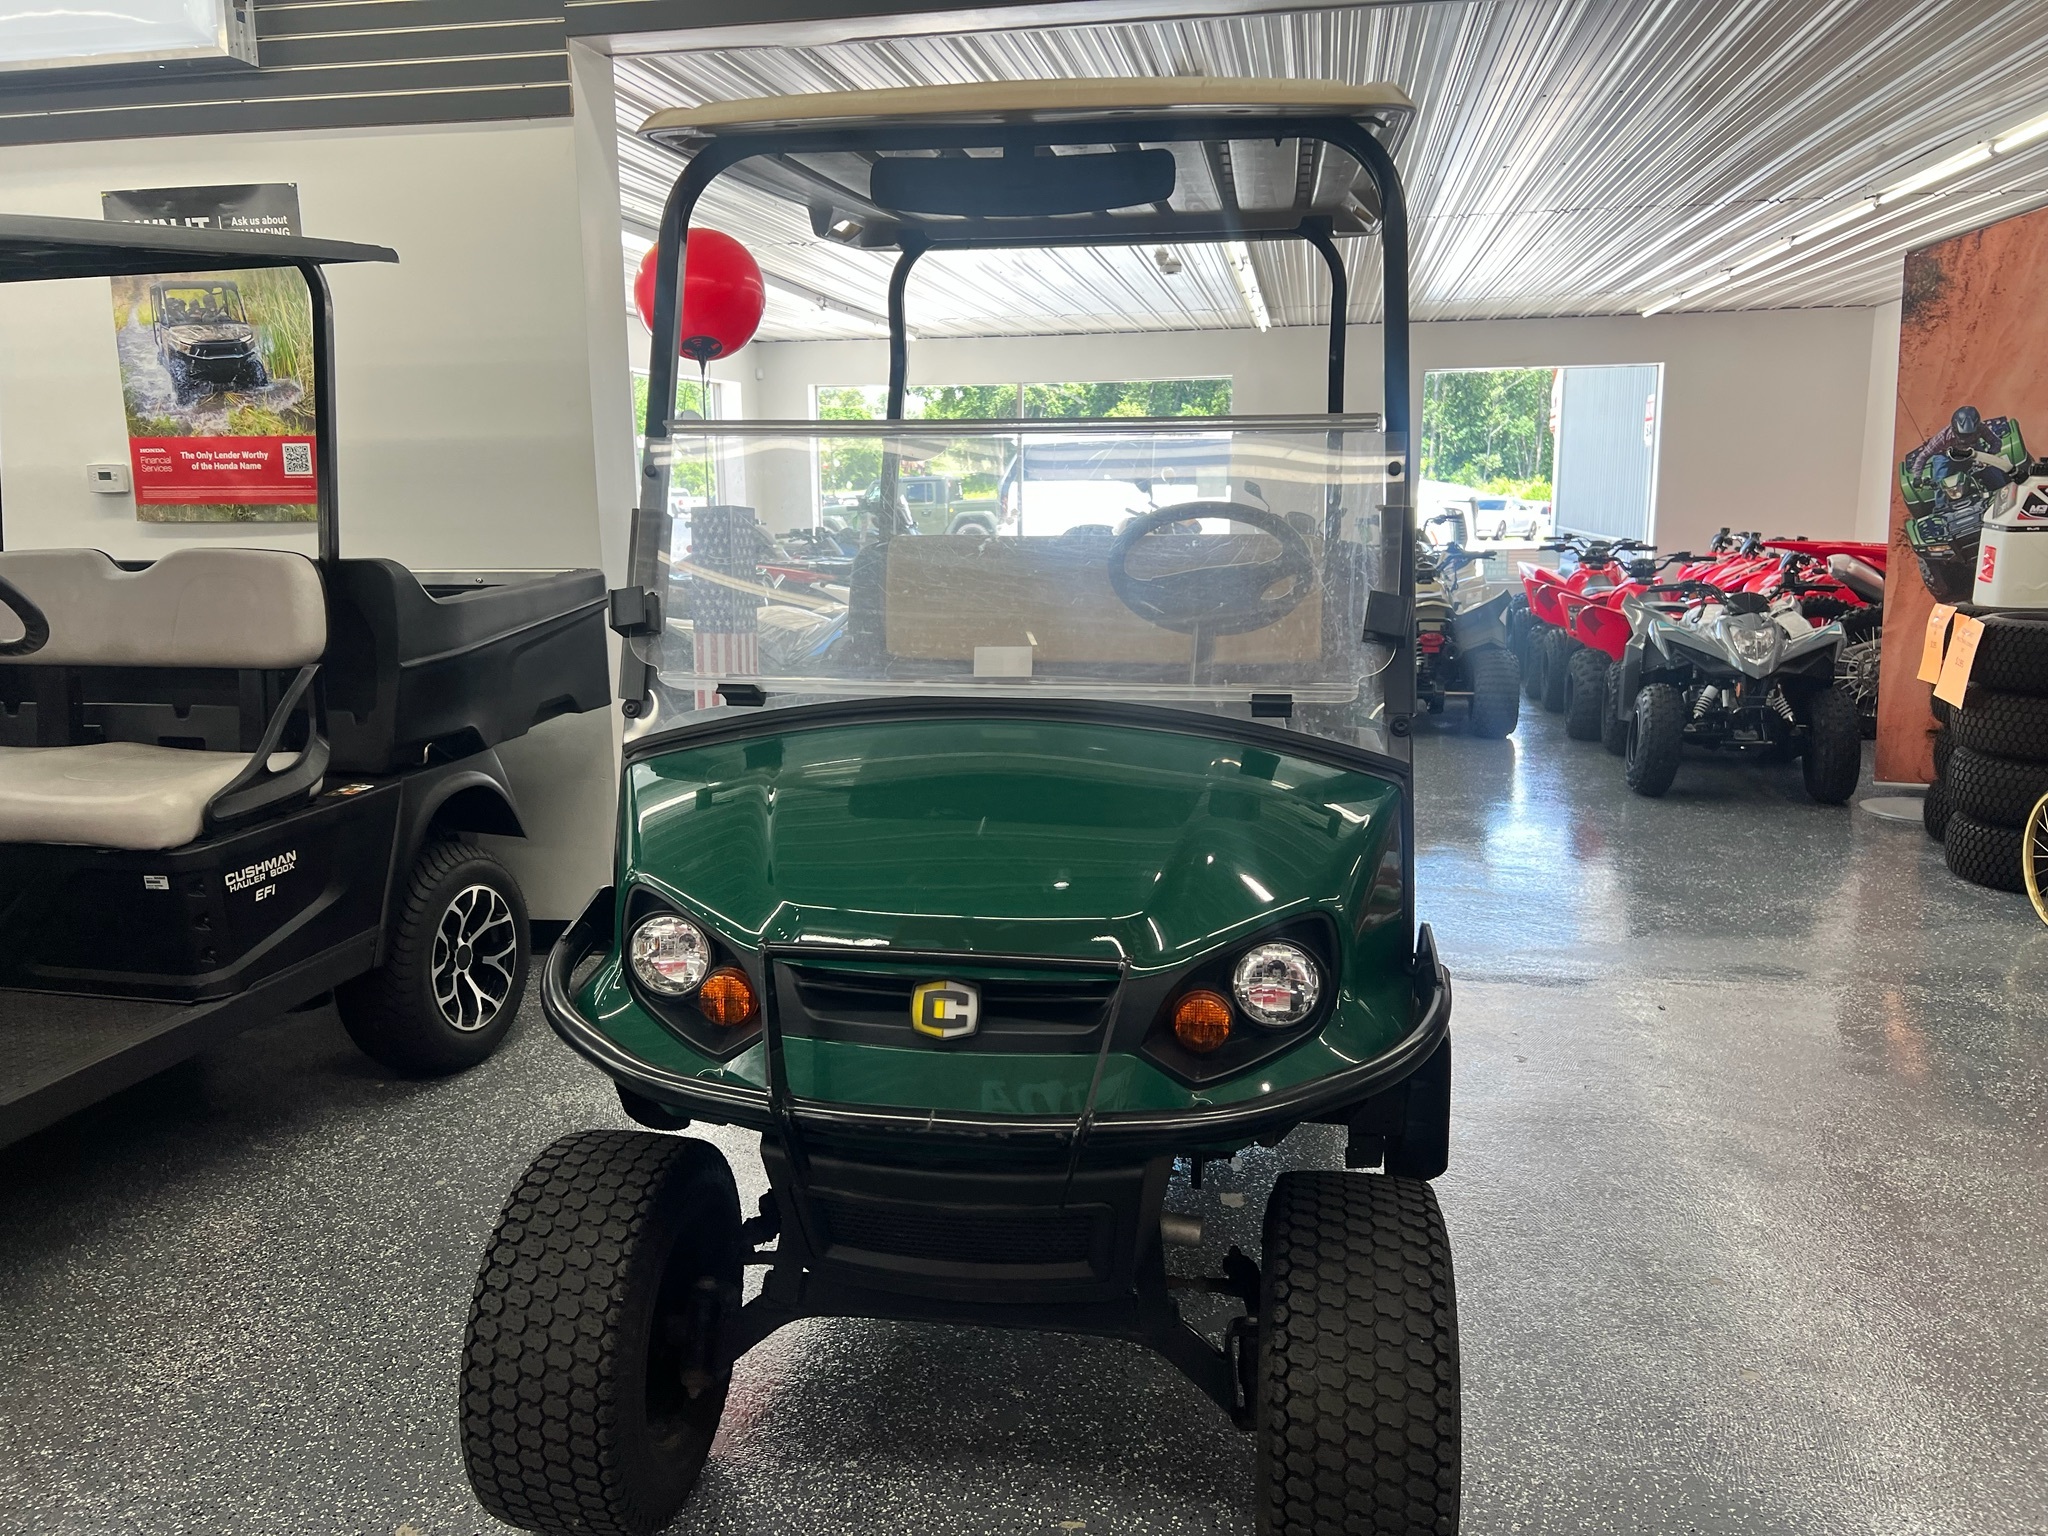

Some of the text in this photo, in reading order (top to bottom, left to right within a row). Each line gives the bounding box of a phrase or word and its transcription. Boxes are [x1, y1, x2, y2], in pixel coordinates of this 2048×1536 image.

[231, 215, 288, 226] Ask us about
[140, 456, 172, 465] Financial
[180, 450, 269, 461] The Only Lender Worthy
[141, 464, 173, 473] Services
[191, 461, 262, 470] of the Honda Name
[224, 850, 297, 886] CUSHMAN
[229, 874, 266, 893] HAULER
[255, 884, 276, 902] EFI
[922, 989, 969, 1030] C
